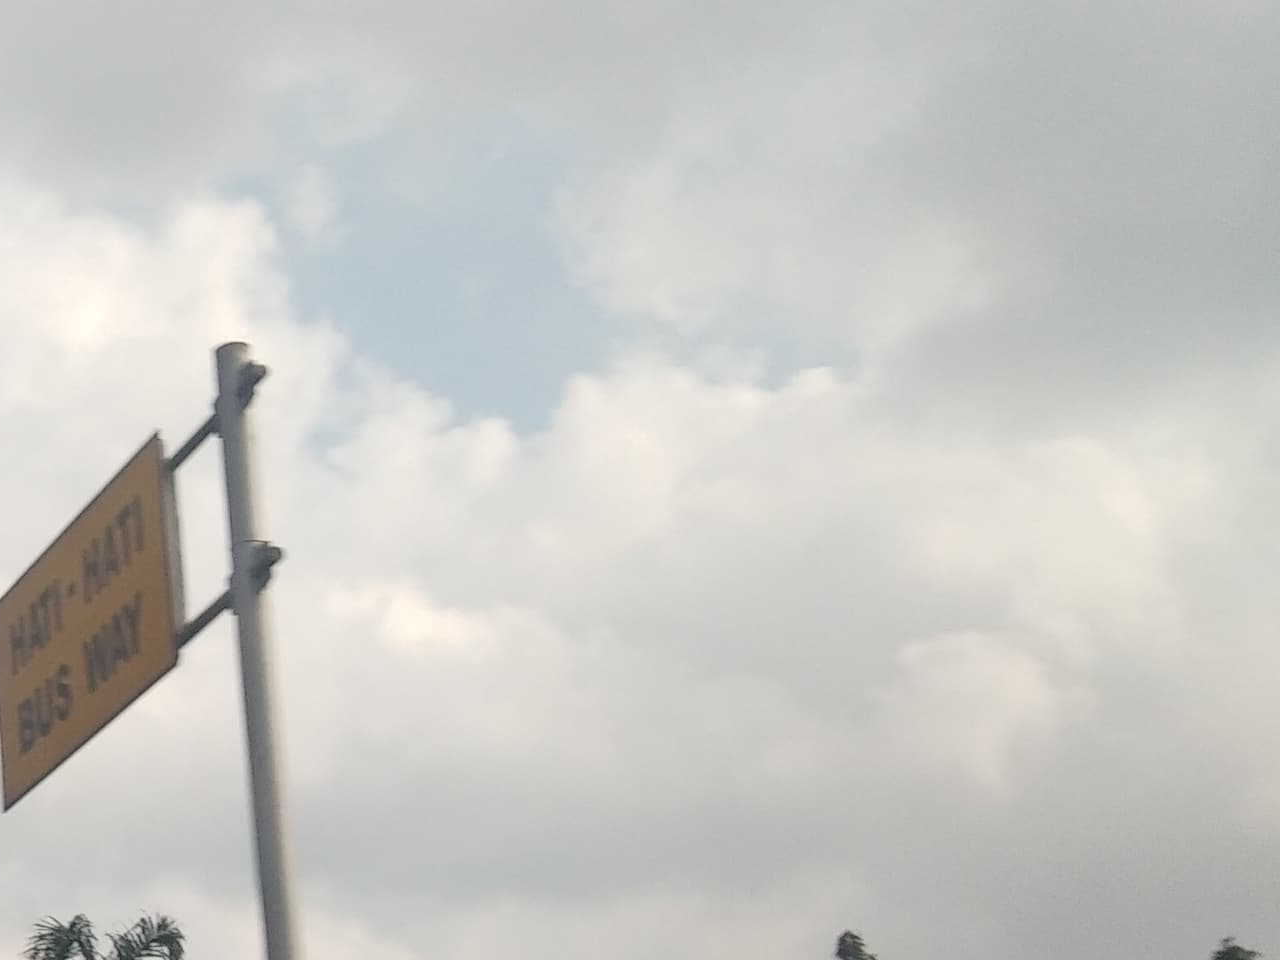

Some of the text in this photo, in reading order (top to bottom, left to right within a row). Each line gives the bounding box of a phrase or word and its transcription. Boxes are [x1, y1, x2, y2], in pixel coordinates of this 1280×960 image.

[9, 578, 63, 675] HATI
[81, 494, 146, 602] HATI
[17, 592, 142, 754] BUS WAY
